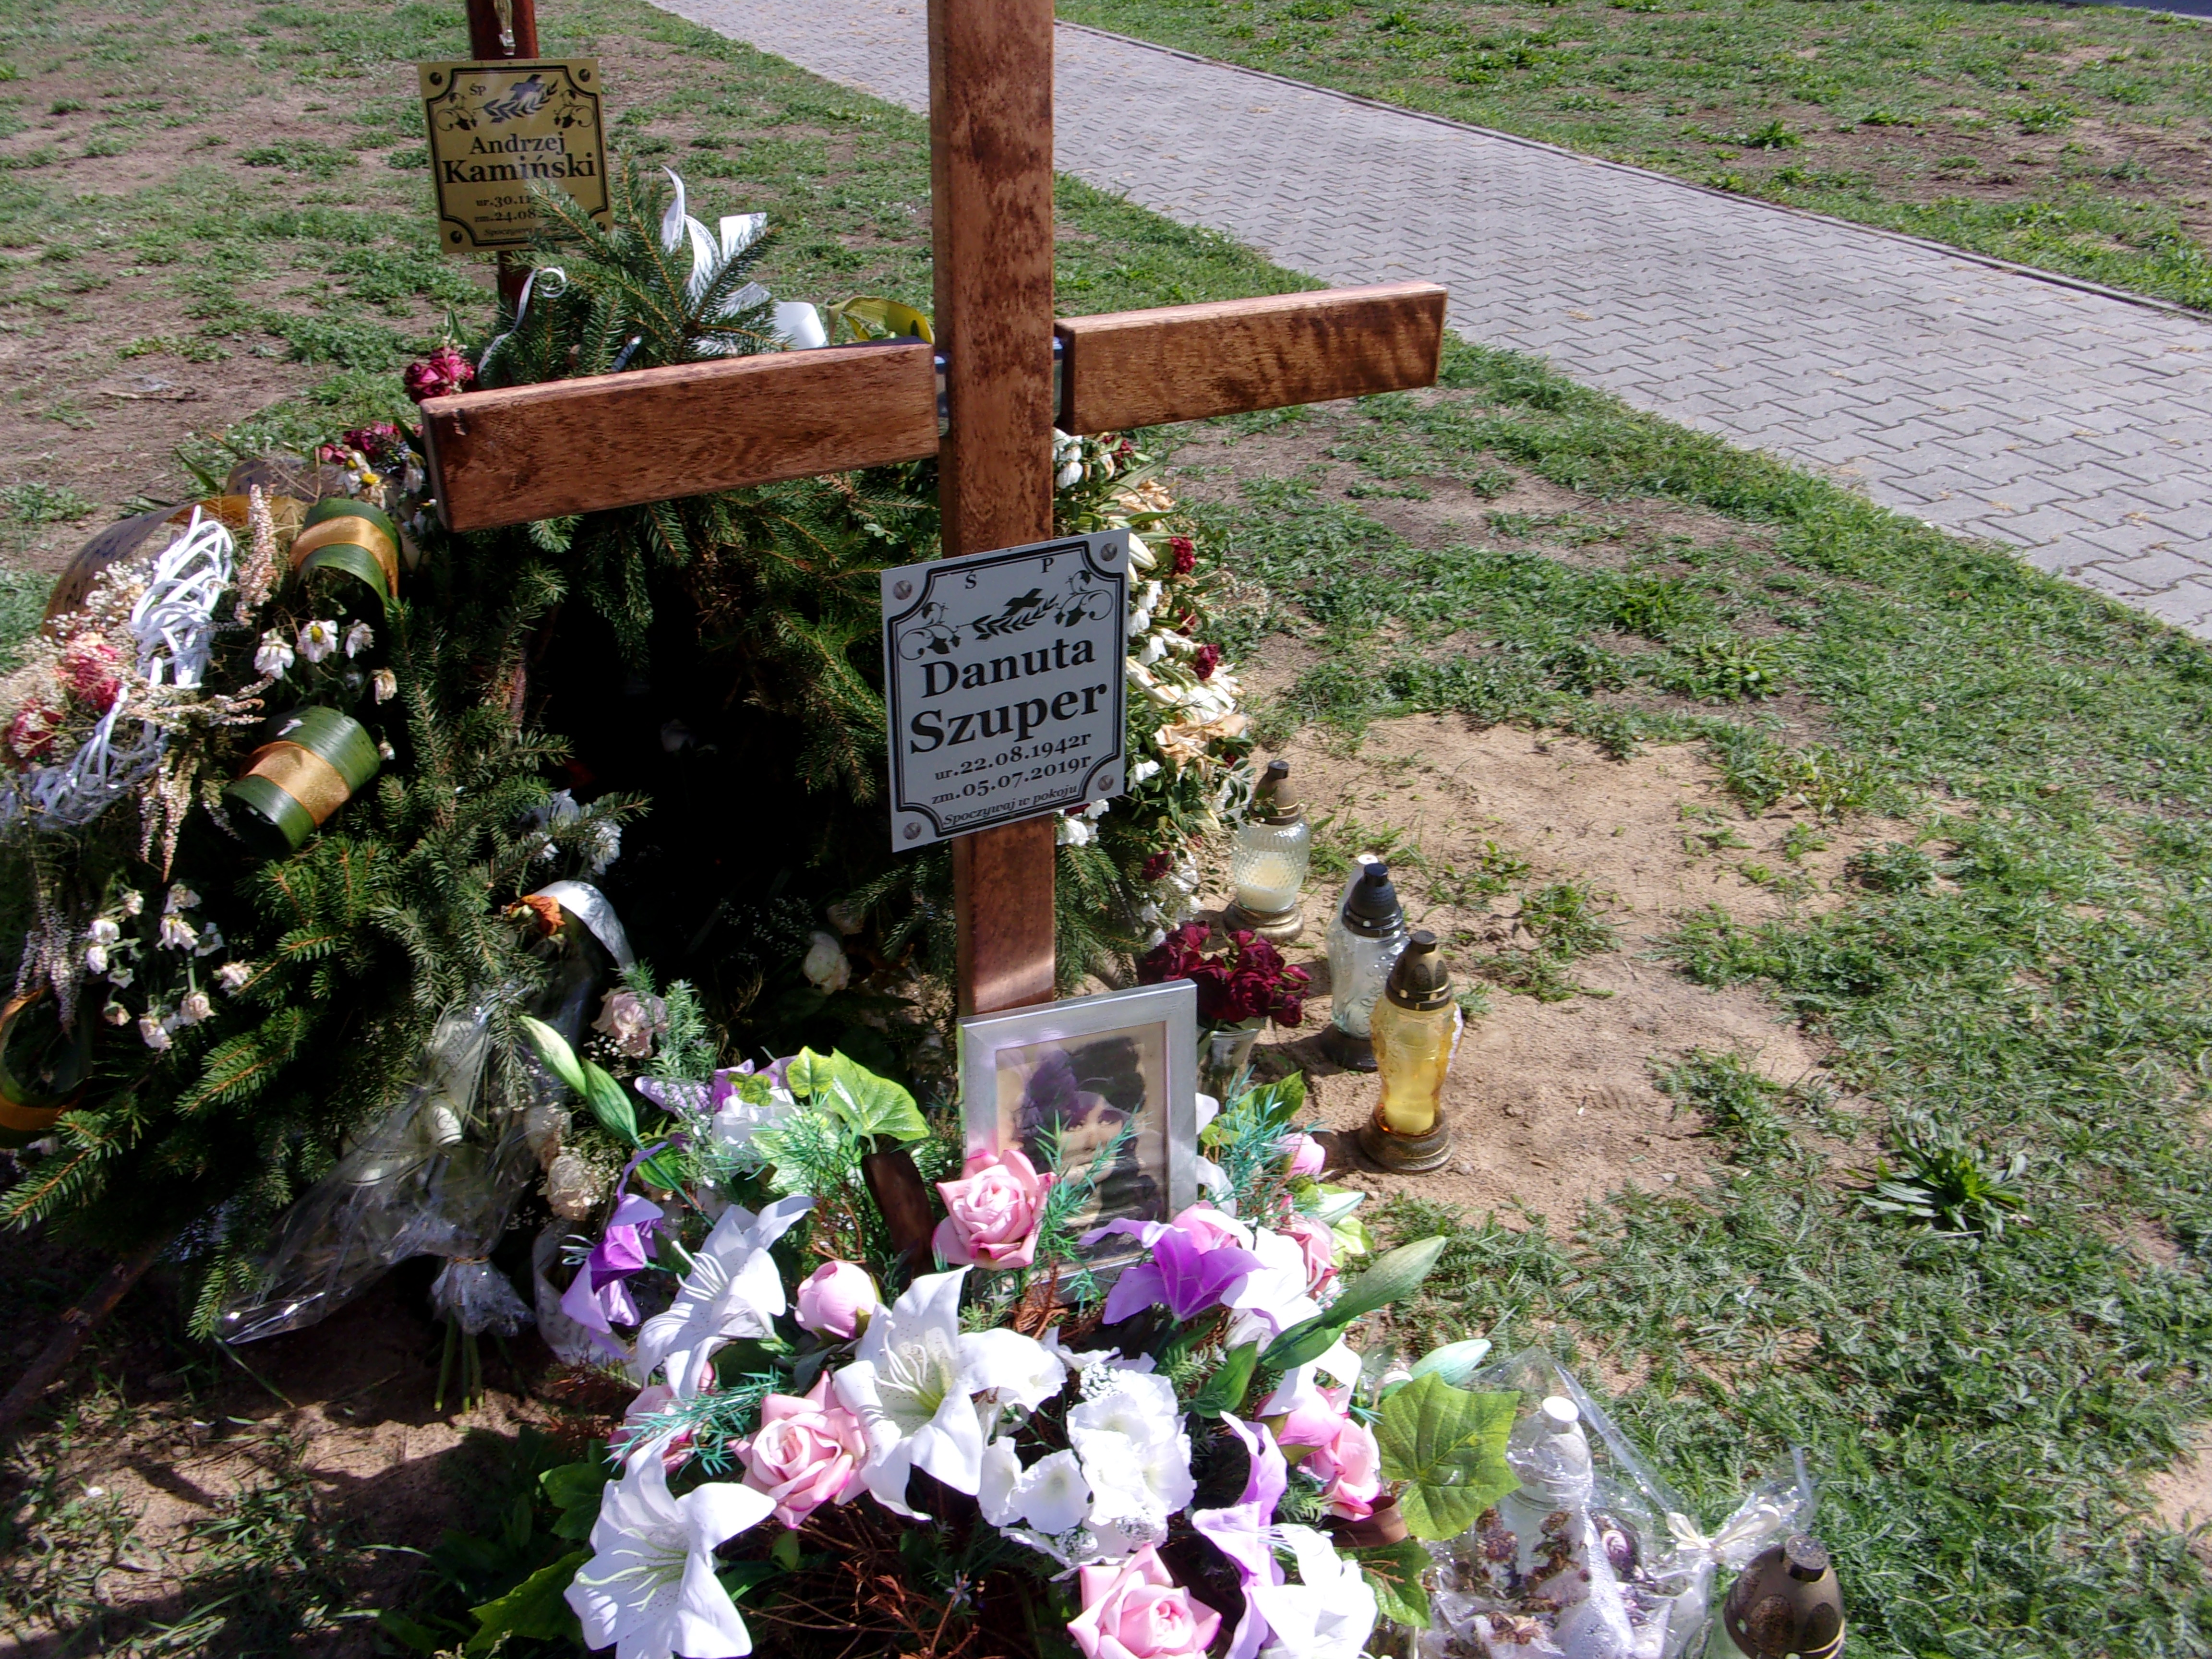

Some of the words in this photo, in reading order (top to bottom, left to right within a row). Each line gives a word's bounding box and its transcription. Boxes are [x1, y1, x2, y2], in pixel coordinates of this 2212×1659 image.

[469, 131, 565, 155] Andrzej
[442, 152, 597, 183] Kamiński
[1040, 557, 1054, 574] P
[919, 638, 1096, 698] Danuta
[910, 683, 1107, 754] Szuper
[934, 733, 1092, 781] ur.22.08.1942r
[931, 755, 1092, 805] zm.05.07.2019r
[942, 799, 1015, 826] Spoczywaj
[1018, 797, 1031, 806] w
[1033, 785, 1078, 805] pokoju
